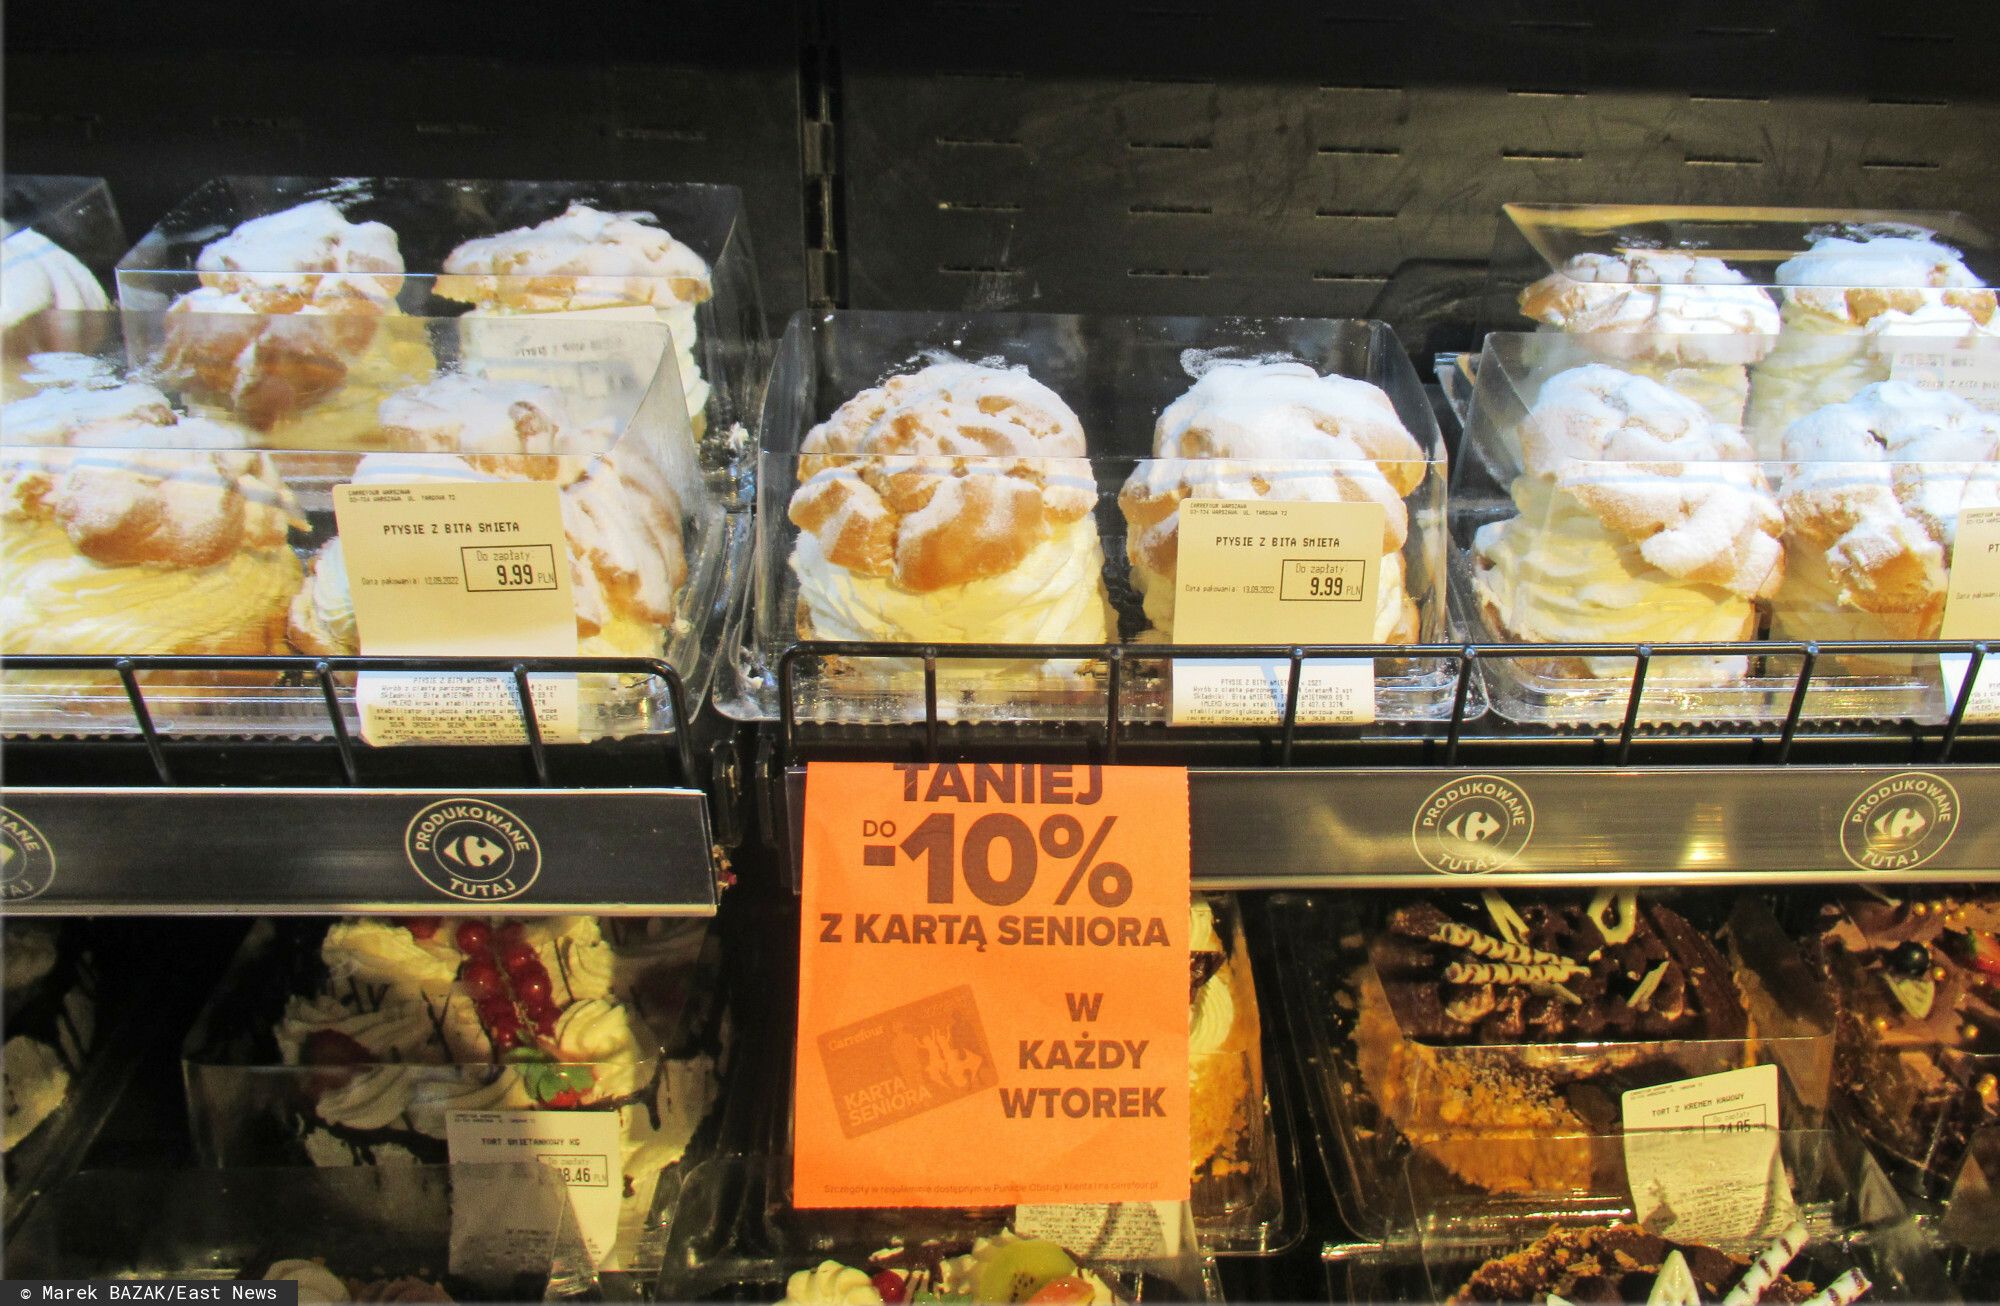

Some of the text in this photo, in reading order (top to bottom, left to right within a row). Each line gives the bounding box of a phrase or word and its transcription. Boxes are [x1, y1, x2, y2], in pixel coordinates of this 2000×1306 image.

[383, 521, 520, 535] PTYSIE Z BITA SMIETA
[1216, 536, 1340, 548] PTYSIE Z BITA SMIETA
[476, 550, 488, 562] Do
[1295, 562, 1306, 574] Do
[496, 563, 554, 586] 9.99 PLN
[1310, 577, 1361, 596] 9.99 PLN
[893, 763, 1103, 806] TANIEJ
[1423, 782, 1526, 826] PRODUKOWANE
[1852, 780, 1953, 823] PRODUKOWANE
[415, 806, 530, 852] PRODUKOWANE
[863, 819, 896, 838] DO
[863, 812, 1134, 907] -10%
[1438, 852, 1498, 871] TUTAJ
[1862, 849, 1920, 868] TUTAJ
[449, 878, 516, 897] TUTAJ
[819, 912, 1171, 953] Z KARTĄ SENIORA
[1065, 992, 1104, 1023] W
[828, 1024, 888, 1052] Carrefour
[1018, 1031, 1150, 1070] KAŻDY
[842, 1076, 906, 1111] KARTA
[998, 1087, 1167, 1119] WTOREK
[1652, 1106, 1670, 1117] TORT
[1674, 1105, 1681, 1113] Z
[1684, 1098, 1713, 1111] KREMEM
[1716, 1092, 1745, 1106] KAWOWY
[849, 1086, 933, 1127] SENIORA
[481, 1137, 502, 1146] TORT
[824, 1184, 869, 1196] Szczegóły
[934, 1184, 982, 1195] dostępnym
[1029, 1183, 1060, 1194] Obsługi
[1064, 1182, 1093, 1191] Klienta
